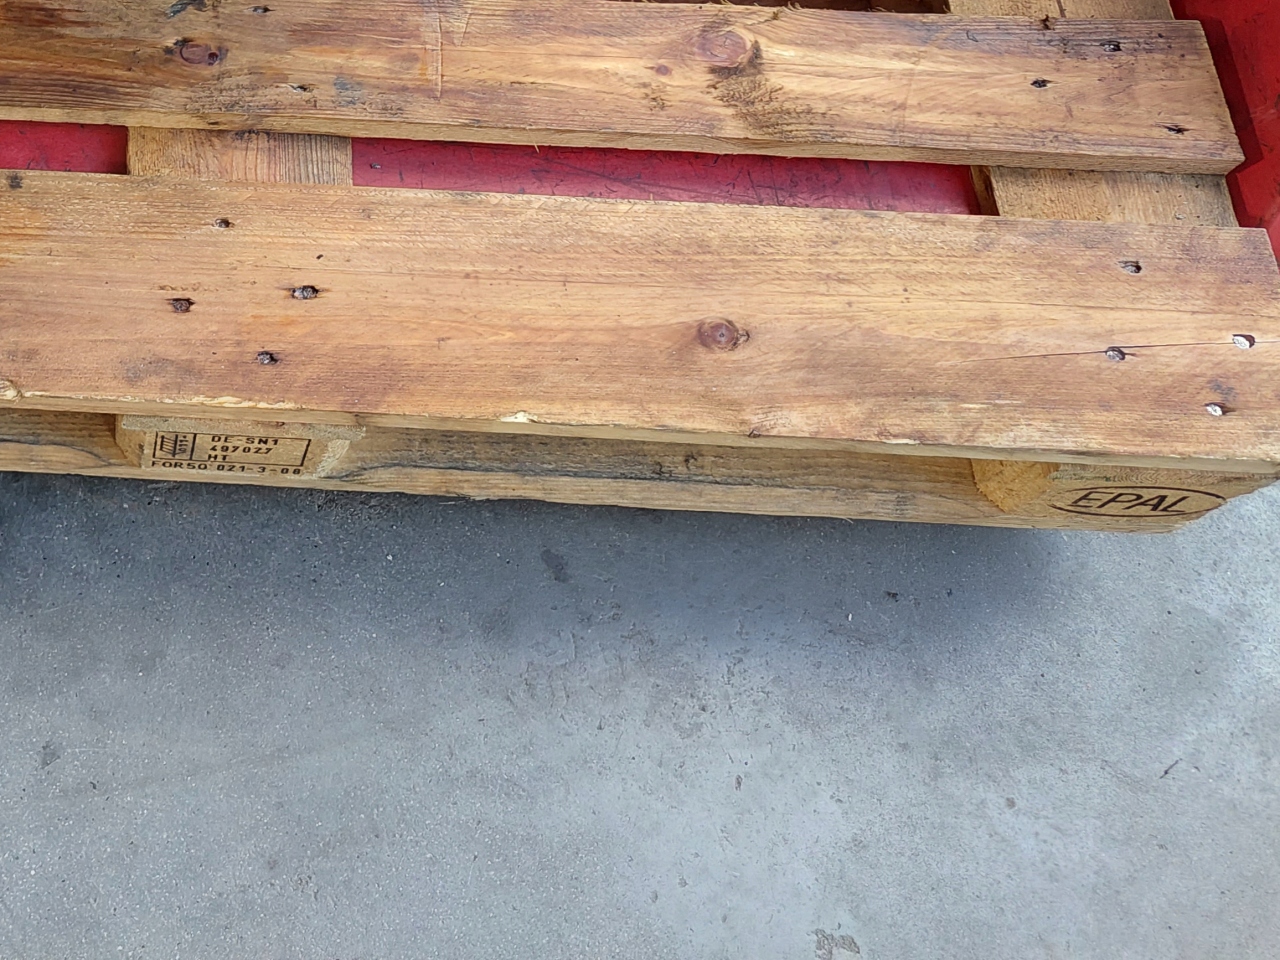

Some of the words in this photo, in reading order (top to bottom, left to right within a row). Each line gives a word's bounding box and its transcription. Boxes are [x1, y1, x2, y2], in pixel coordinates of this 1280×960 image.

[211, 435, 279, 446] DE-SN1
[209, 444, 274, 455] 497027
[207, 453, 229, 461] HT
[216, 463, 301, 475] 021-3-08
[1066, 490, 1190, 513] EPAL
